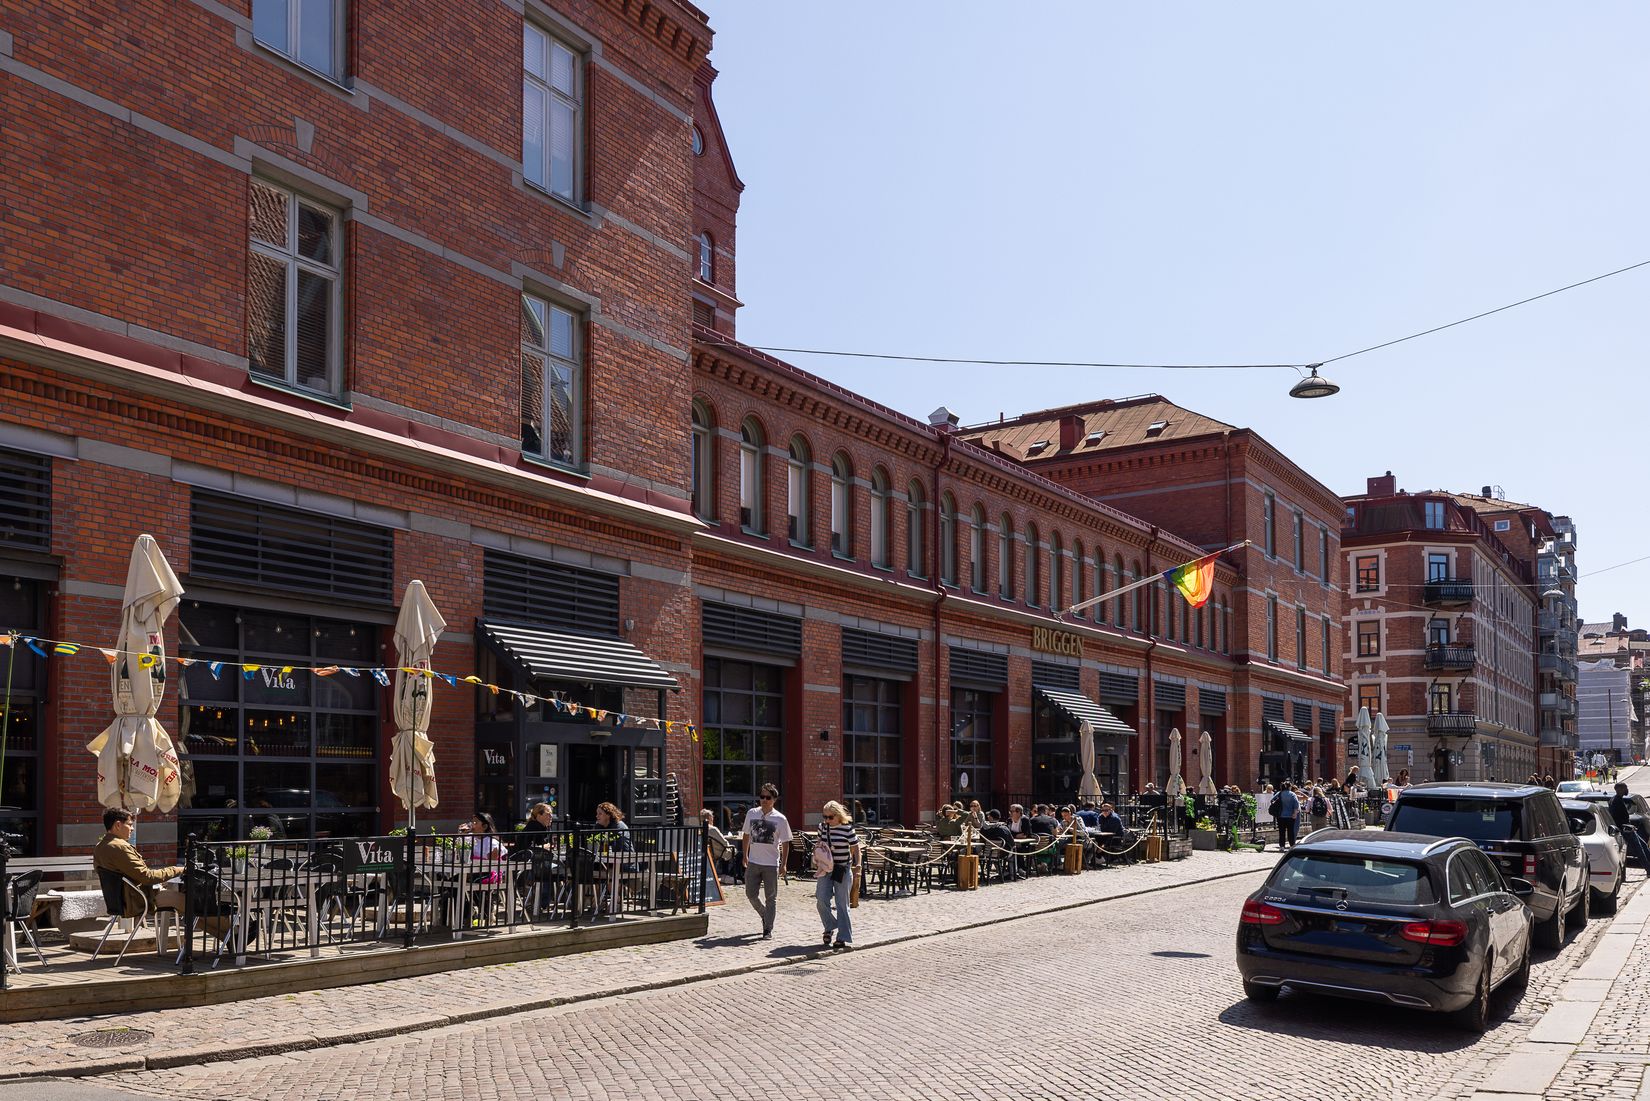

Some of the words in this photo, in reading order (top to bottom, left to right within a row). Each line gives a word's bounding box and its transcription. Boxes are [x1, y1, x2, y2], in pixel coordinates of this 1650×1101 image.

[1033, 626, 1085, 657] BRIGGEN
[483, 749, 506, 765] Vita
[355, 841, 394, 864] Vita
